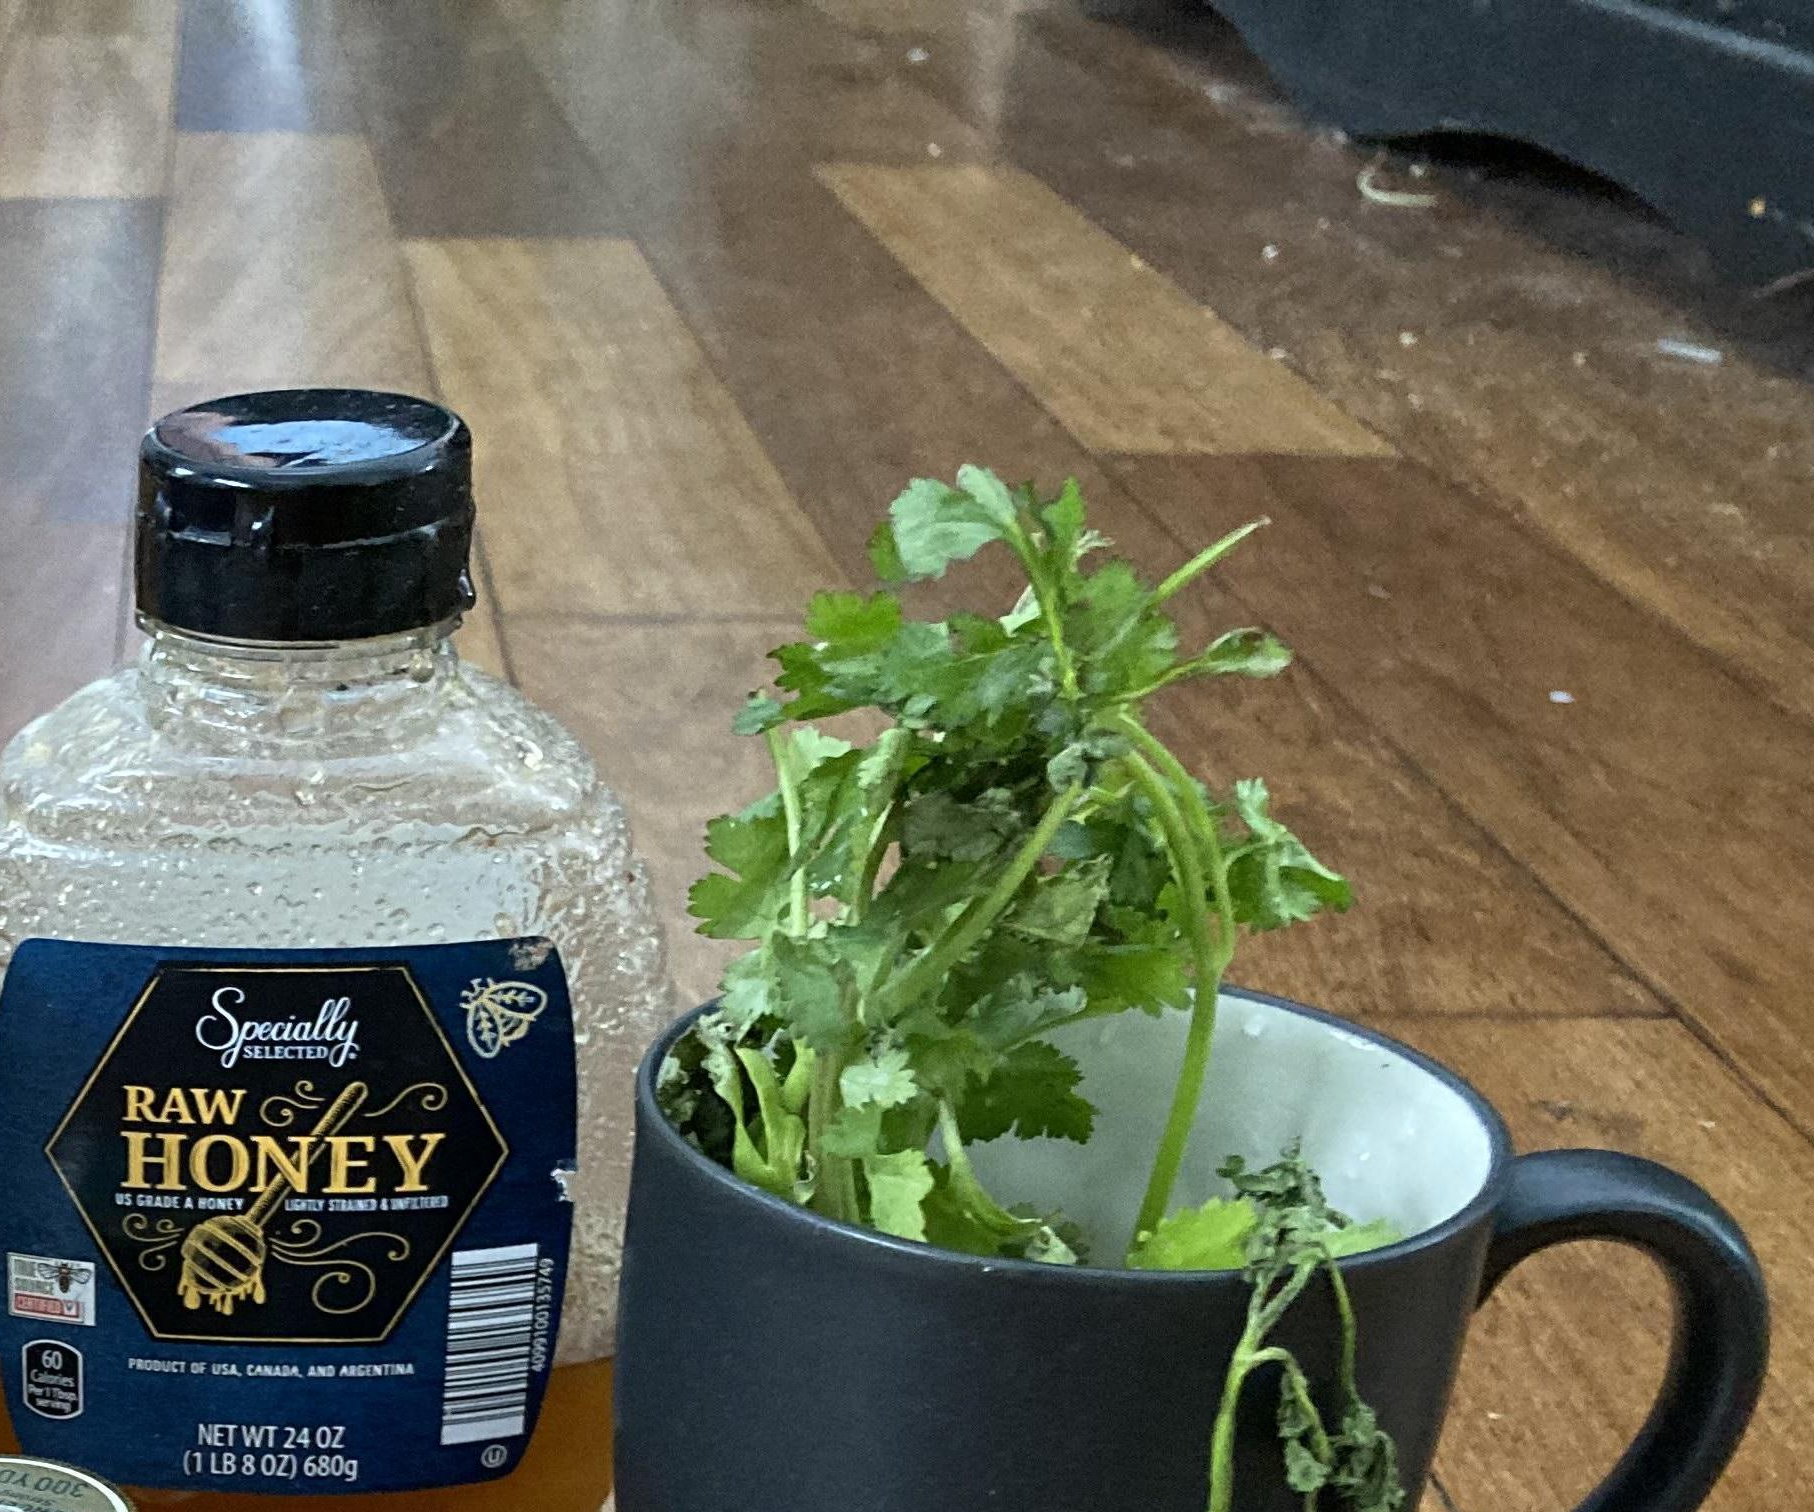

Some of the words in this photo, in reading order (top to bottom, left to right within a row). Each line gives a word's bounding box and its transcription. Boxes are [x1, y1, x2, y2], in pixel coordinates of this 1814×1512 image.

[195, 986, 359, 1068] Specially
[242, 1045, 328, 1059] SELECTED
[123, 1085, 246, 1124] RAW
[121, 1131, 446, 1194] HONEY
[115, 1193, 132, 1206] US
[136, 1194, 180, 1209] GRADE
[184, 1197, 194, 1209] A
[198, 1197, 244, 1211] HONEY
[41, 1349, 63, 1370] 60
[128, 1358, 186, 1373] PRODUCT
[190, 1362, 206, 1374] OF
[306, 1365, 336, 1377] AND
[338, 1363, 415, 1377] ARGENTINA
[30, 1368, 75, 1388] Calories
[198, 1423, 238, 1447] NET
[241, 1425, 278, 1448] WT
[283, 1427, 311, 1449] 24
[315, 1426, 346, 1449] OZ
[183, 1450, 203, 1476] (1
[210, 1452, 236, 1475] LB
[241, 1454, 256, 1476] 8
[260, 1454, 298, 1480] OZ)
[303, 1455, 358, 1482] 680g
[36, 1477, 87, 1499] 300
